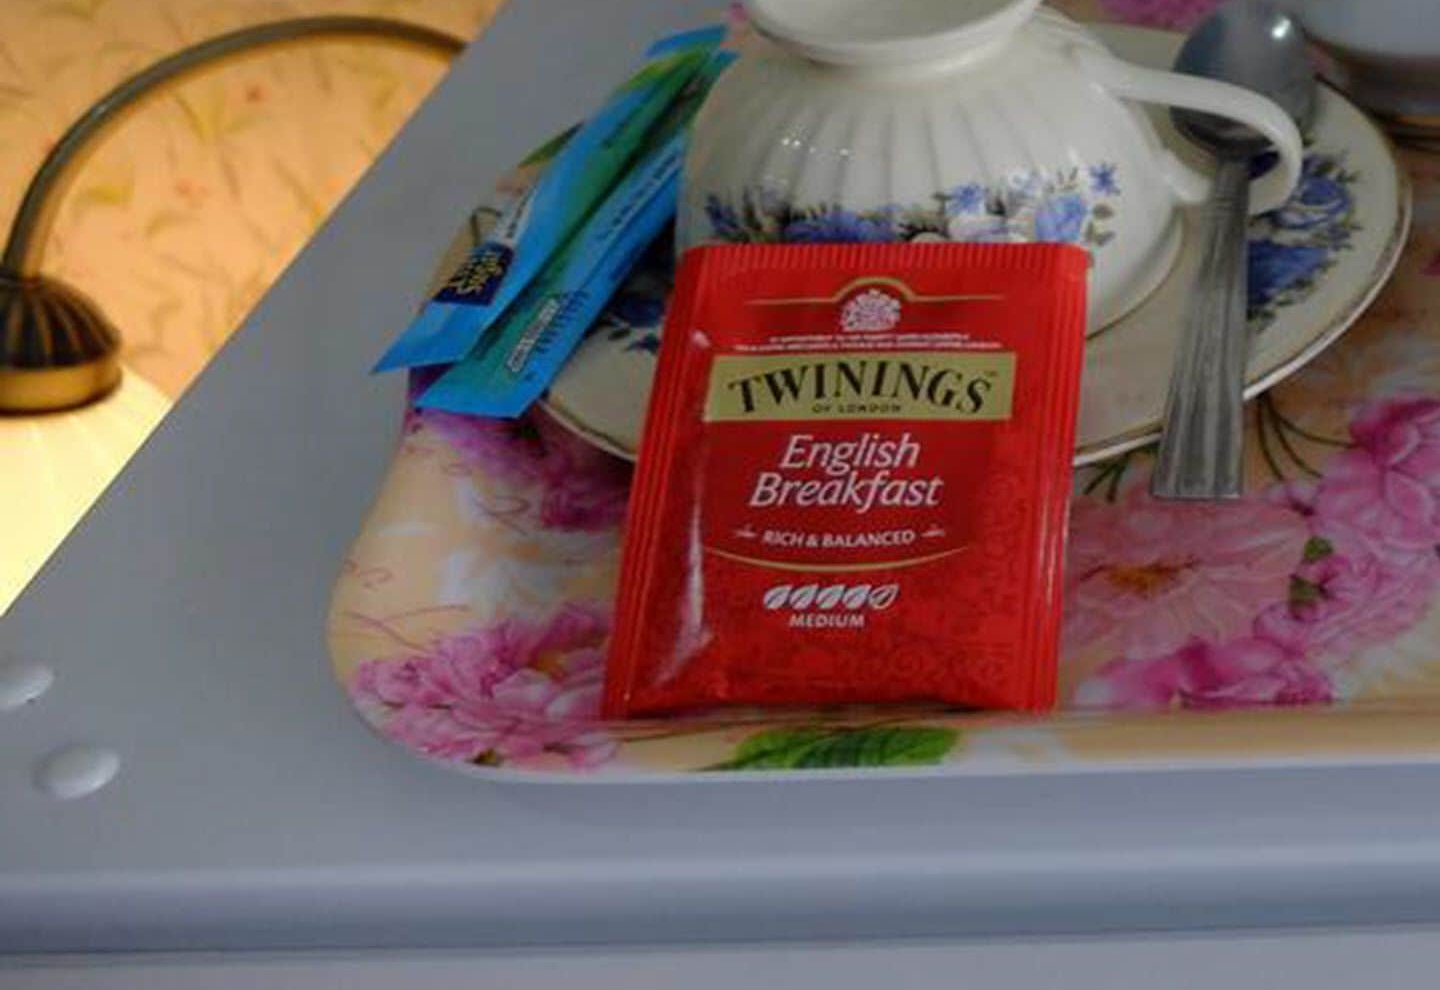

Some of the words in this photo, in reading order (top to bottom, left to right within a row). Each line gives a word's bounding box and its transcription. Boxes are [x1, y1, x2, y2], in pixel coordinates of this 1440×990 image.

[727, 360, 992, 414] TWININGS
[779, 431, 922, 476] English
[751, 470, 945, 514] Breakfast
[762, 529, 806, 547] RICH
[805, 533, 819, 548] &
[822, 528, 917, 548] BALANCED
[788, 613, 866, 630] MEDIUM
